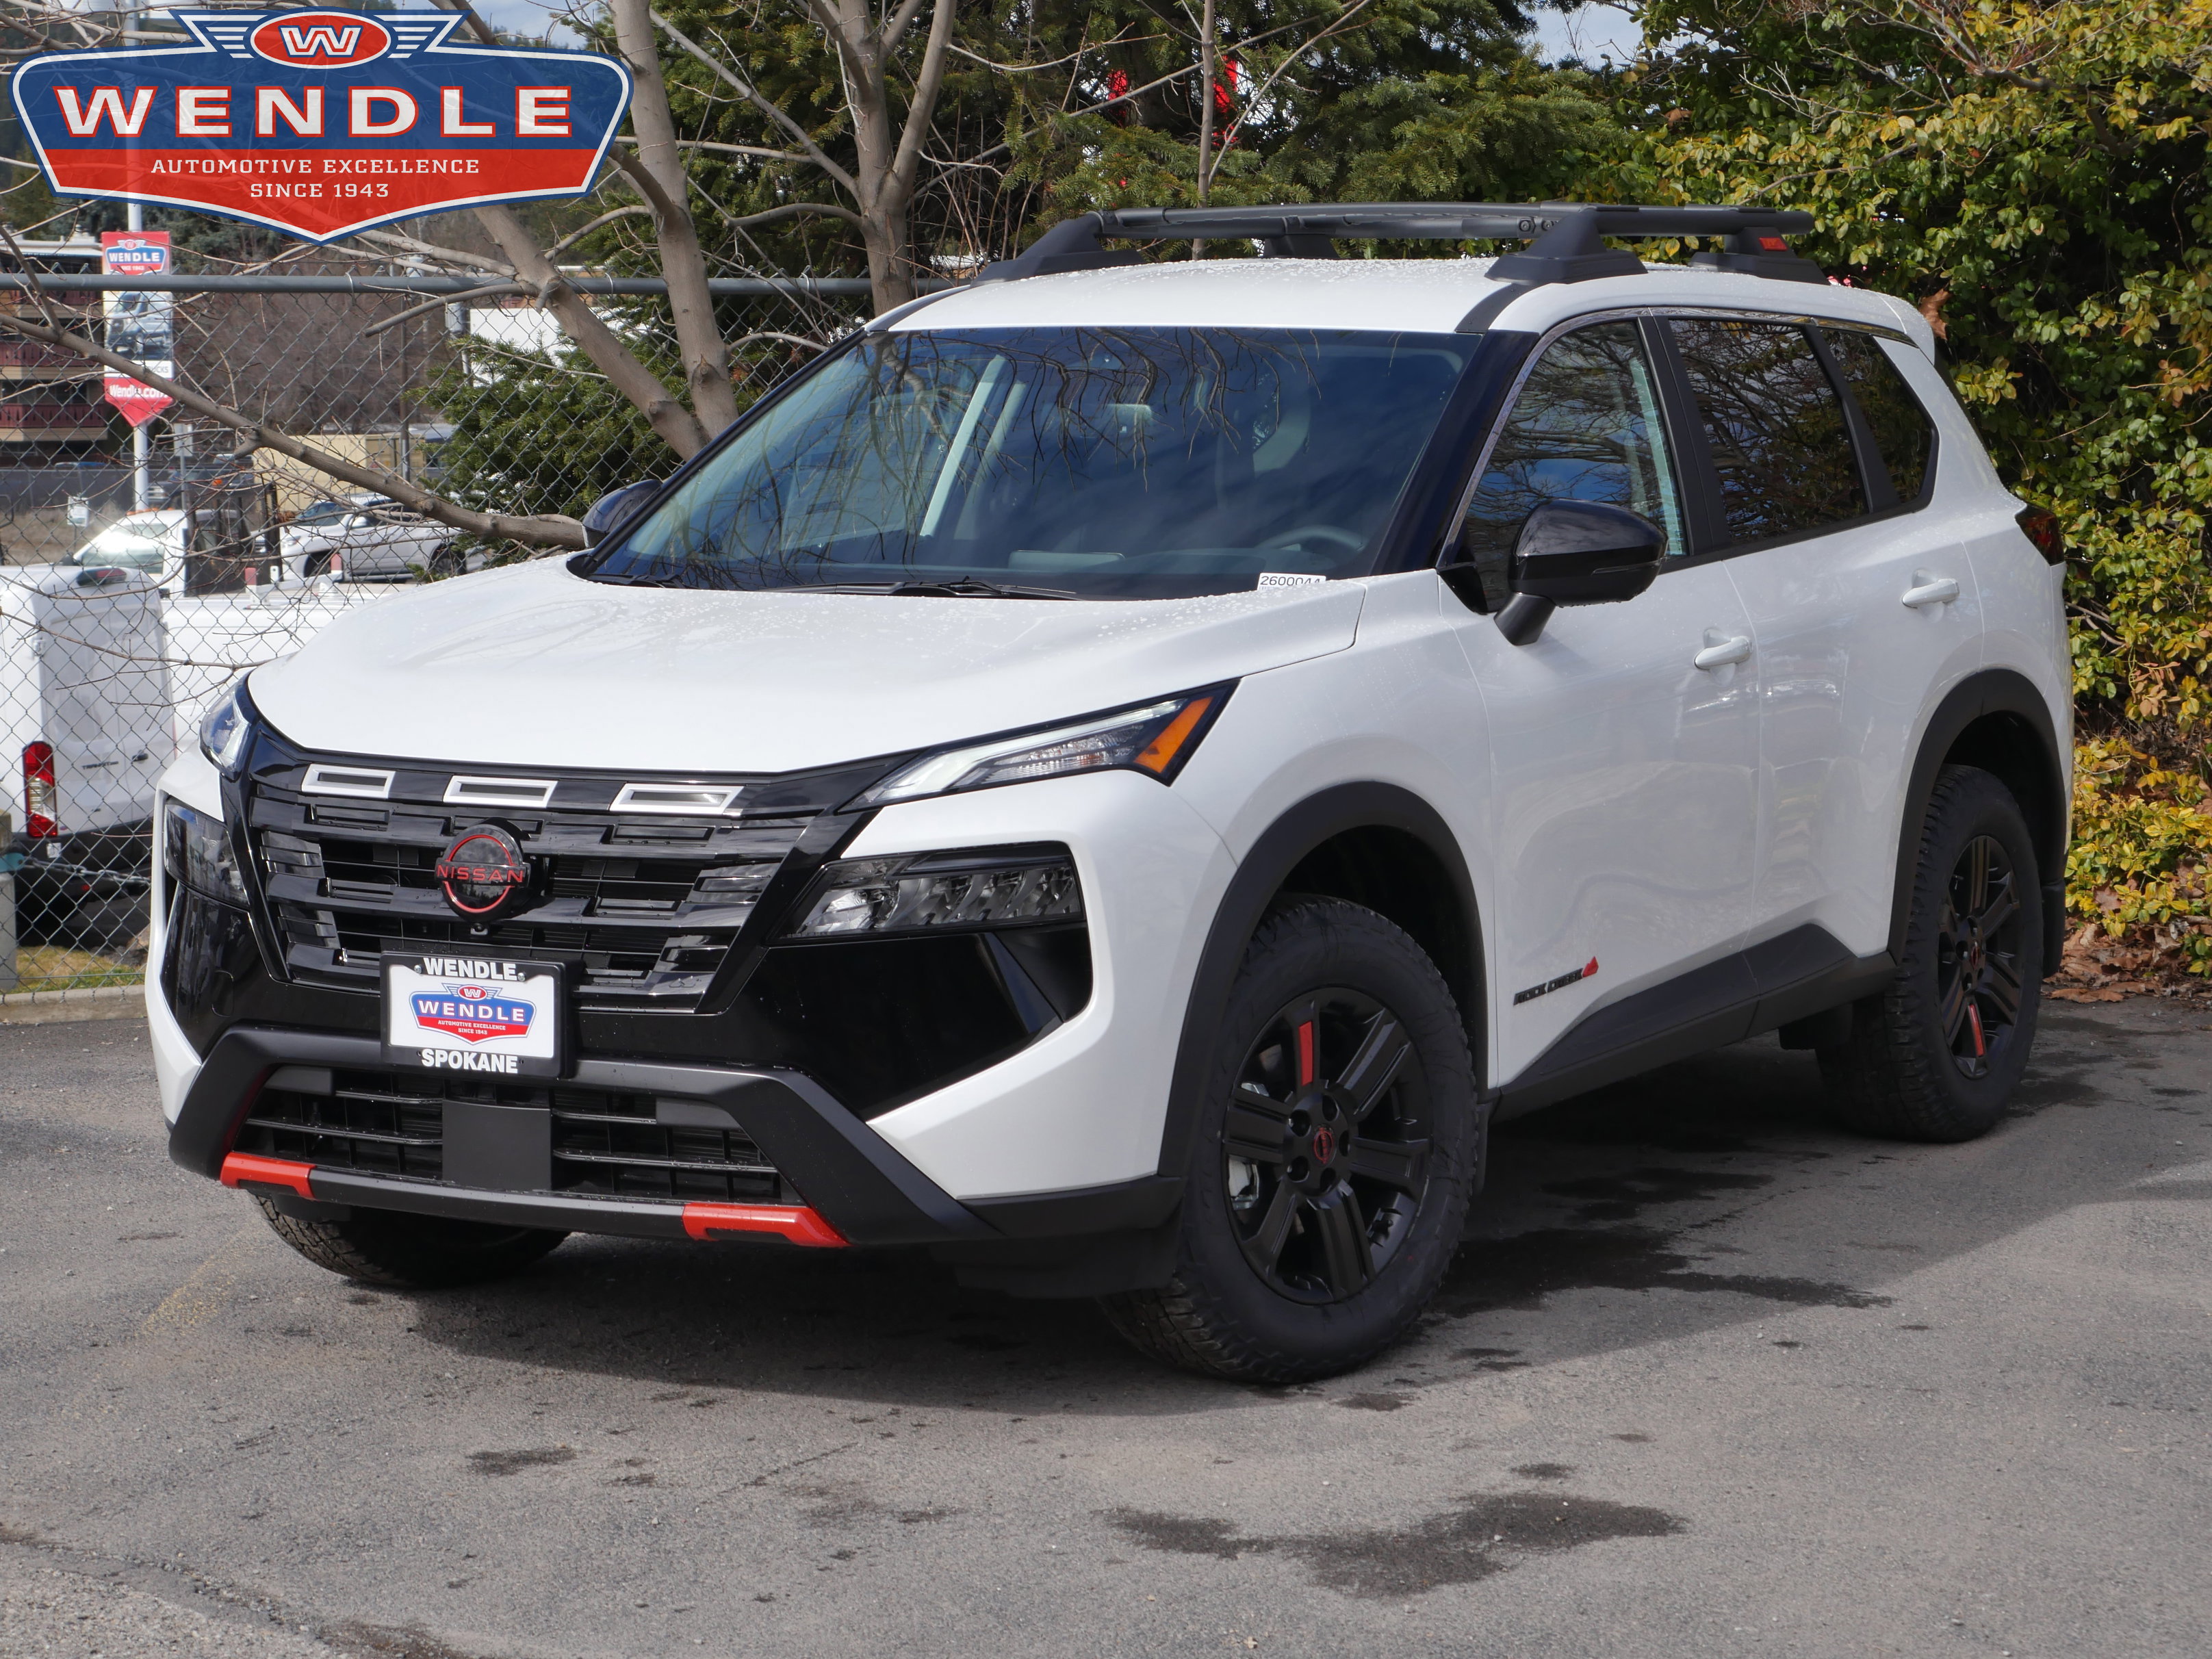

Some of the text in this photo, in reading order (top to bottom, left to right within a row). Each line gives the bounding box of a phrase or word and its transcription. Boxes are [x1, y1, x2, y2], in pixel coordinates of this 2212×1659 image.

[109, 252, 160, 262] WENDLE
[437, 864, 524, 883] NISSAN
[423, 957, 517, 981] WENDLE
[418, 1000, 524, 1022] WENDLE
[422, 1049, 518, 1074] SPOKANE
